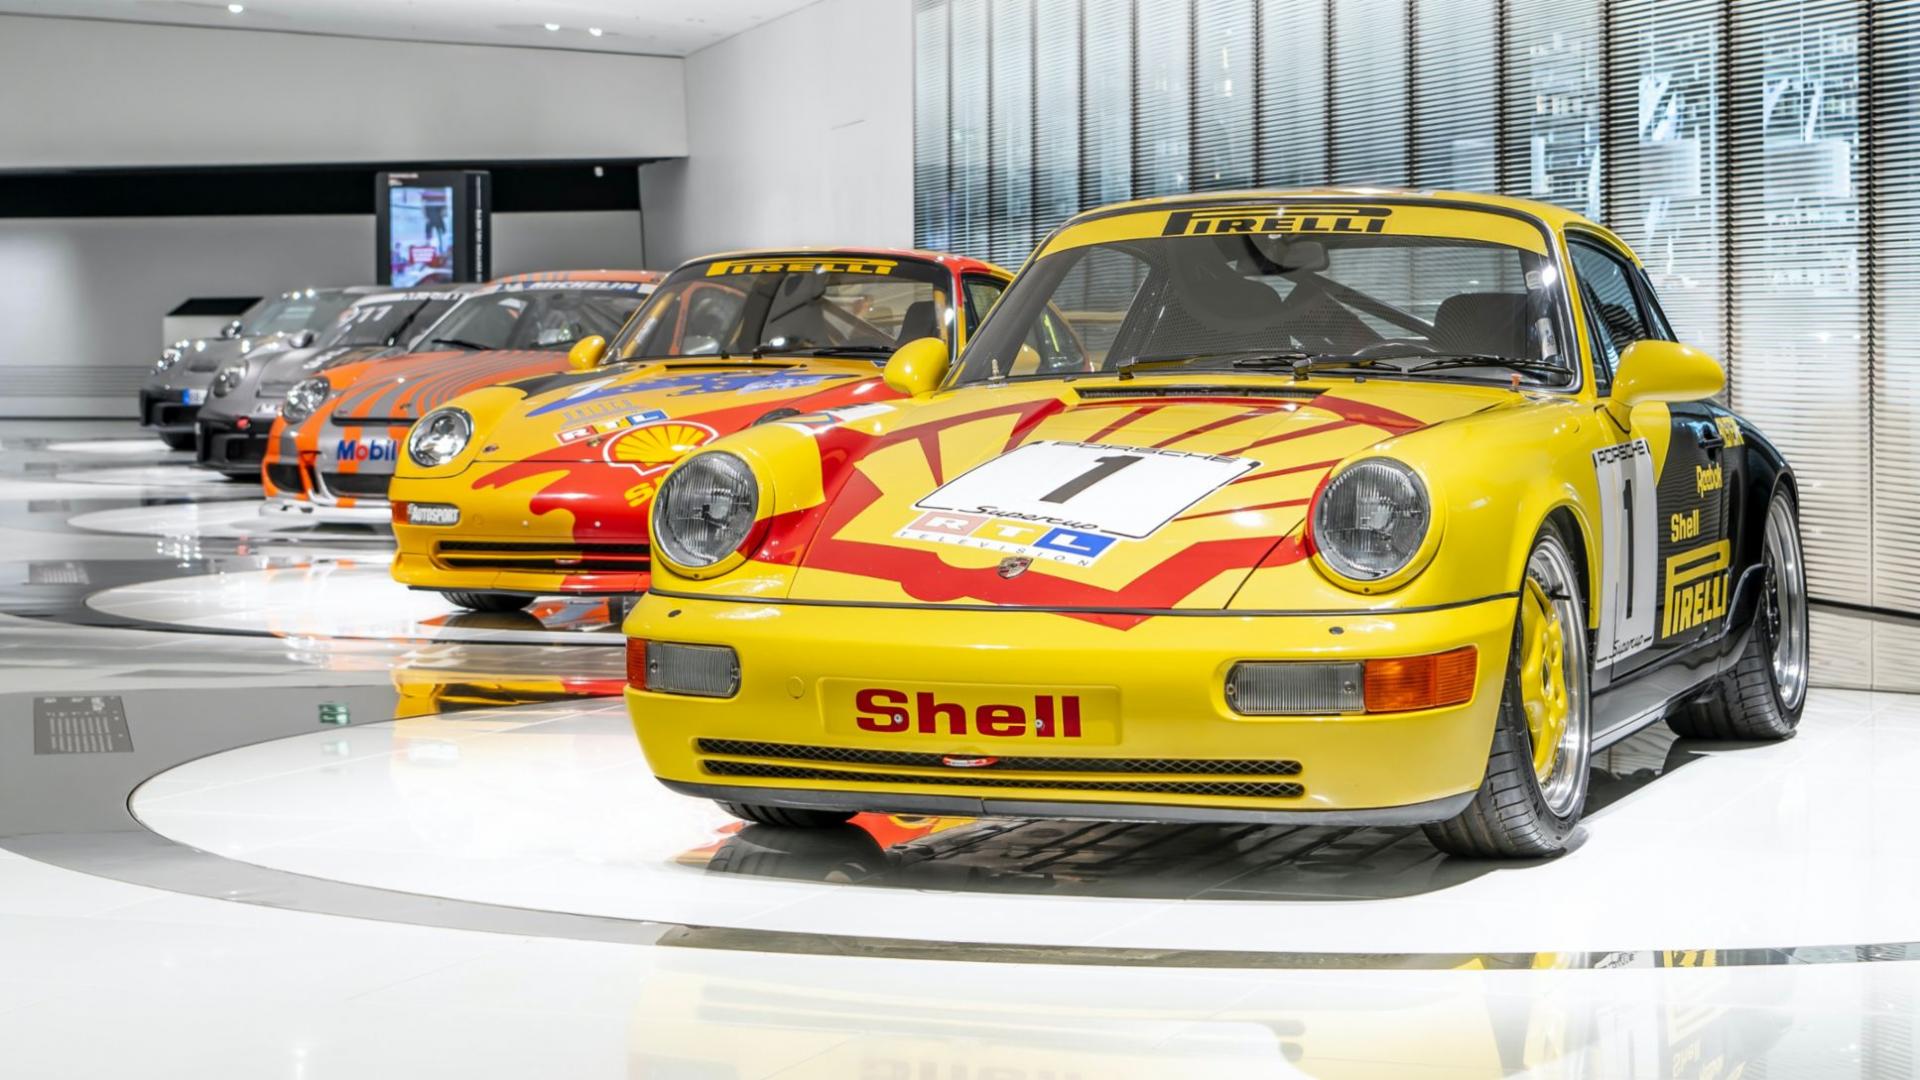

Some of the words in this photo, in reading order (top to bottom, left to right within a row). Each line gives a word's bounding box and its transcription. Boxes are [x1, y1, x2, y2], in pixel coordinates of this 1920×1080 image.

[1161, 207, 1393, 237] PIRELLI
[705, 257, 899, 277] PIRELLI
[529, 281, 639, 290] MICHELIN
[559, 412, 664, 443] RTL
[337, 440, 396, 461] Mobil
[1052, 440, 1241, 464] PORSCHE
[1597, 440, 1645, 465] PORSCHE
[1038, 454, 1145, 505] 1
[922, 514, 1096, 552] RTL
[959, 505, 1100, 530] Supercup
[1670, 509, 1700, 543] Shell
[900, 531, 1090, 566] TELEVISION
[1622, 478, 1635, 619] 1
[1661, 538, 1731, 640] PIRELLI
[856, 688, 1082, 738] Shell
